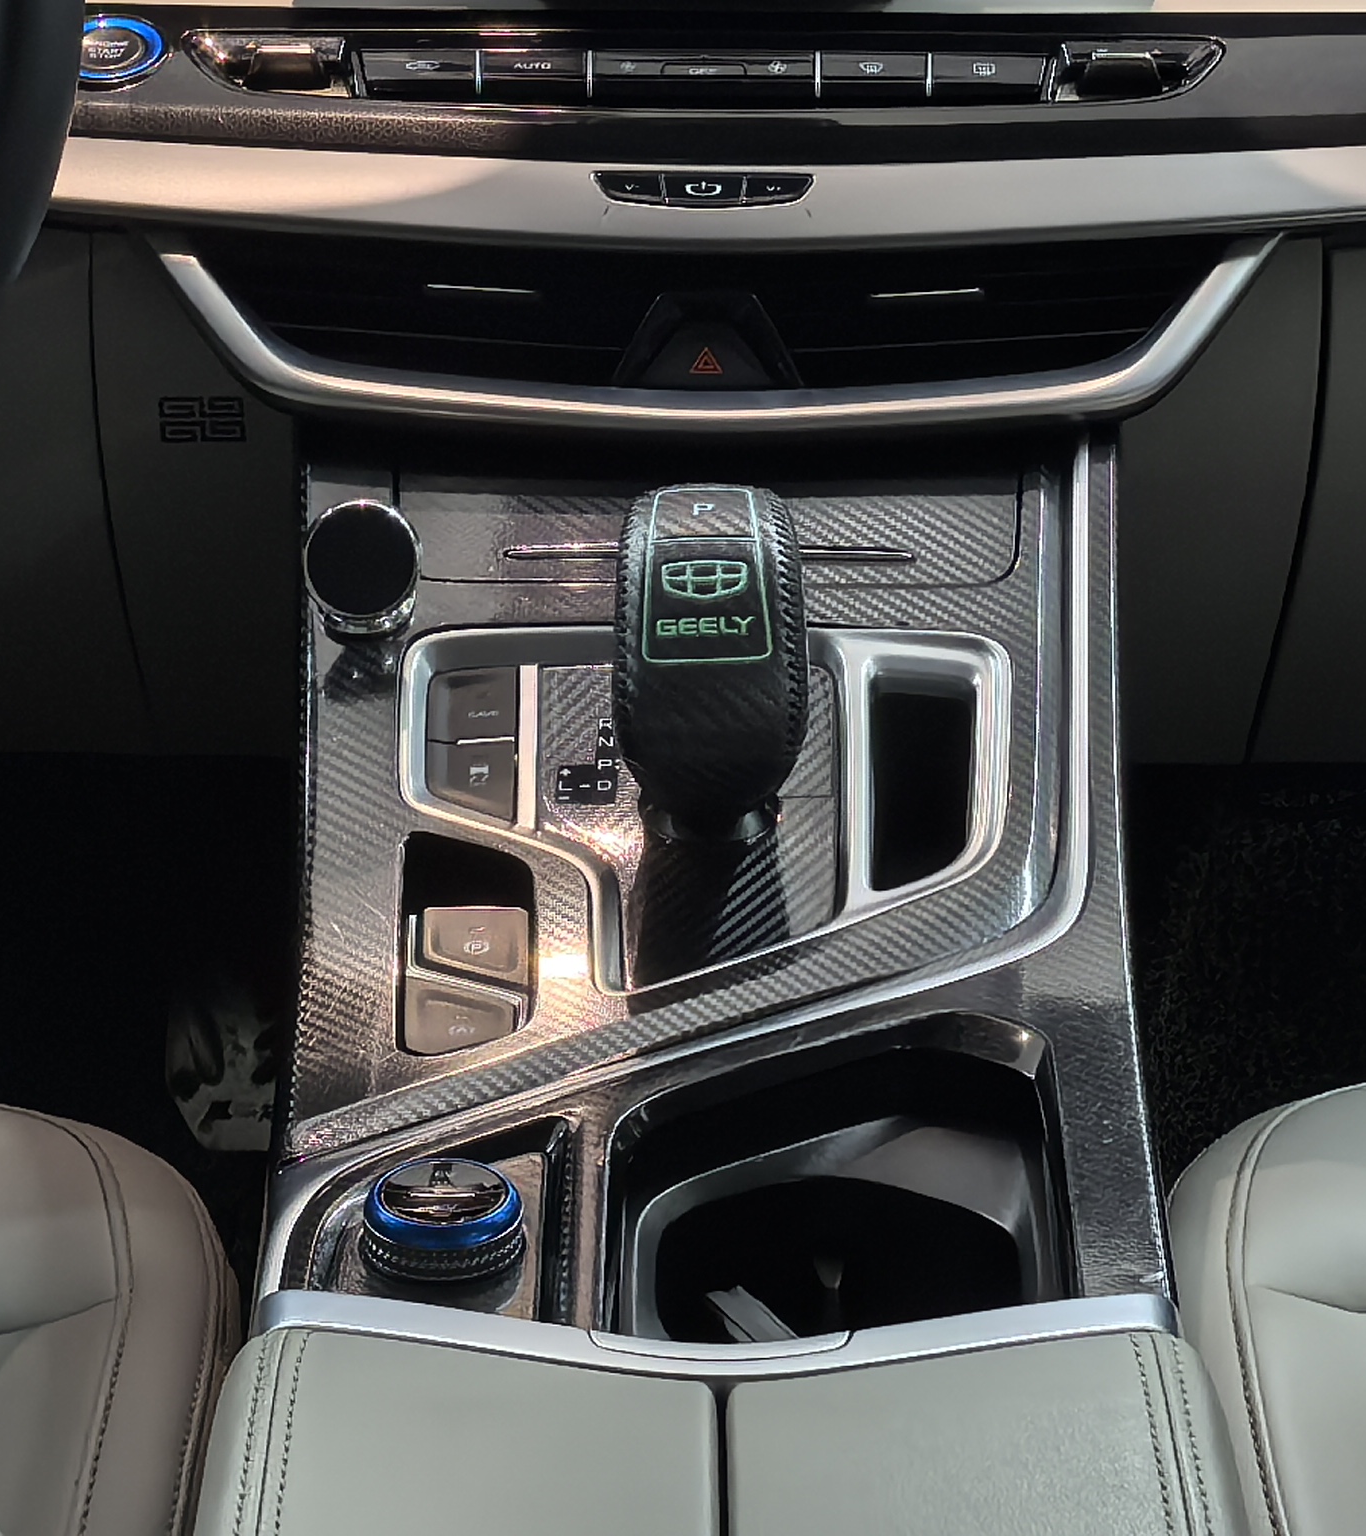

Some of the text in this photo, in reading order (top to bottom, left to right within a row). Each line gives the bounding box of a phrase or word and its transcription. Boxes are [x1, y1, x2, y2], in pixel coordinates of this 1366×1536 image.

[513, 62, 552, 70] AUTO
[693, 503, 715, 516] P
[656, 616, 756, 637] GEELY
[598, 717, 613, 730] R
[598, 736, 615, 747] N
[597, 759, 613, 770] P
[597, 780, 613, 791] D
